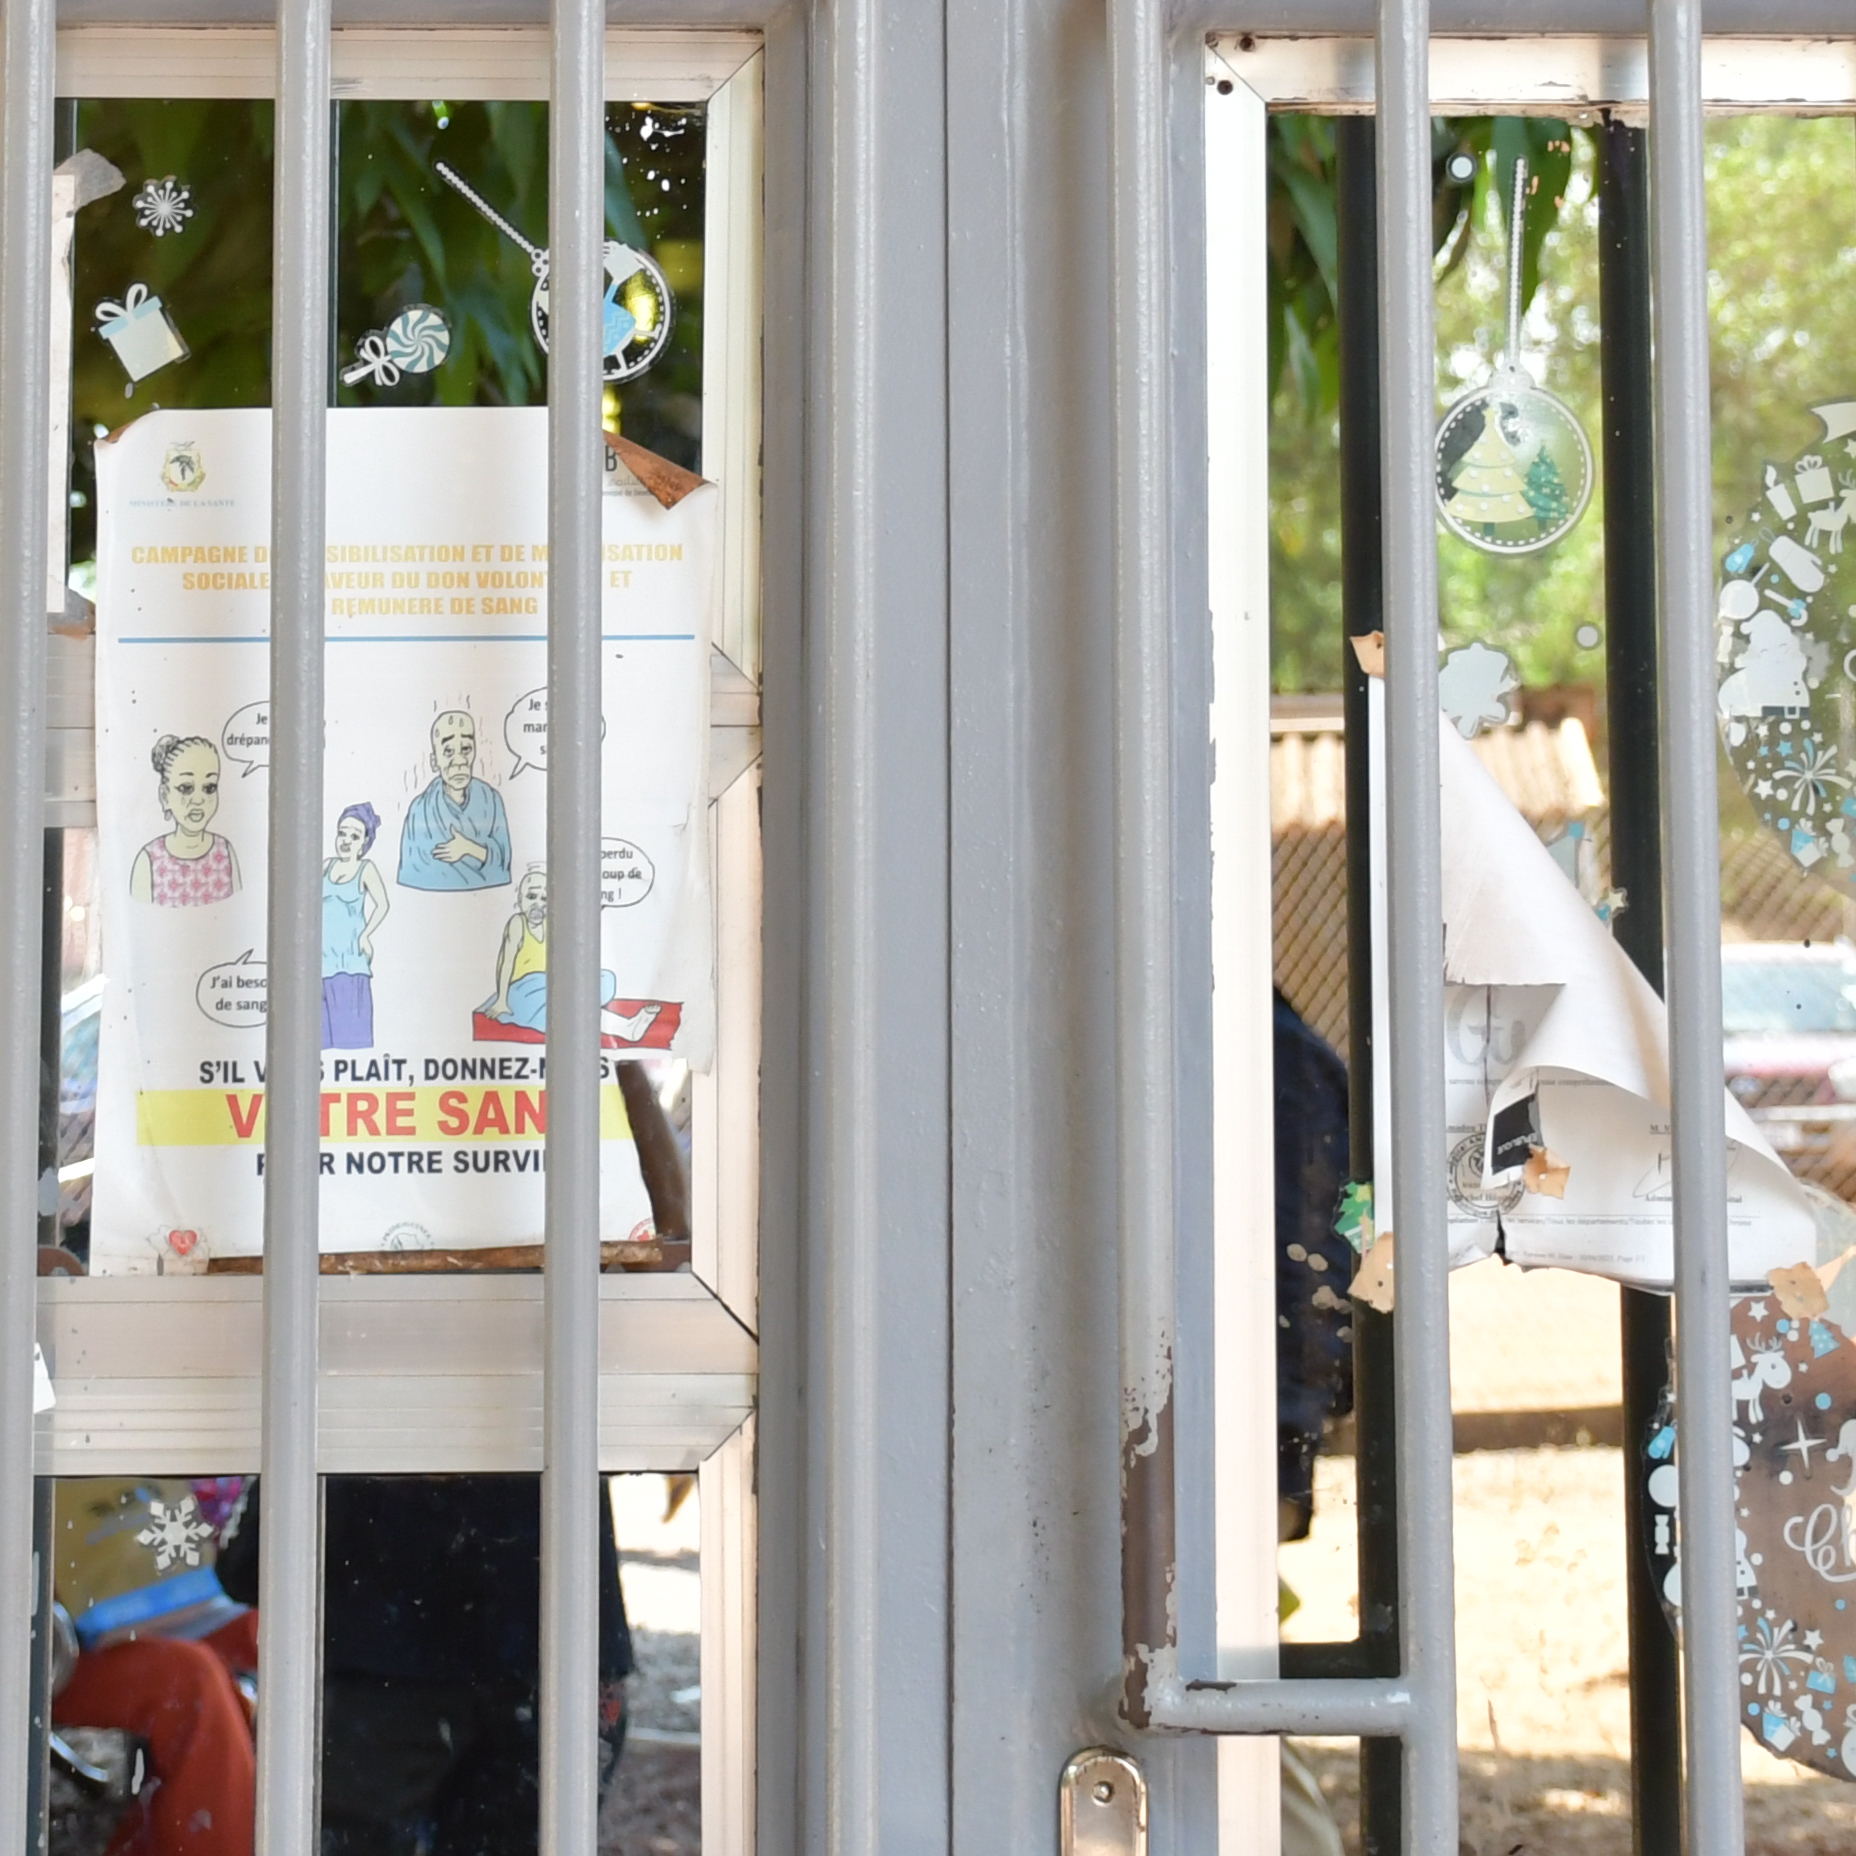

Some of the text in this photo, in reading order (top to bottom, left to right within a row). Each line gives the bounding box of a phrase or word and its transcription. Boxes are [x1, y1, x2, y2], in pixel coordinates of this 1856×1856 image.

[131, 546, 248, 563] CAMPAGNE
[254, 546, 268, 563] D
[325, 545, 466, 562] SIBILISATION
[472, 545, 494, 562] ET
[500, 545, 525, 562] DE
[182, 572, 269, 590] SOCIALE
[391, 572, 420, 589] DU
[427, 572, 470, 589] DON
[476, 571, 547, 589] VOLON
[610, 571, 632, 588] ET
[332, 597, 539, 615] REMUNERE DE SANG
[528, 698, 541, 711] Je
[255, 713, 268, 725] Je
[226, 732, 270, 748] drépan
[210, 975, 267, 989] J'ai beso
[215, 997, 232, 1011] de
[199, 1060, 245, 1084] S'IL
[334, 1053, 415, 1087] PLAÎT,
[225, 1090, 547, 1139] VTRE SAN
[346, 1150, 443, 1175] NOTRE
[453, 1149, 546, 1174] SURVI
